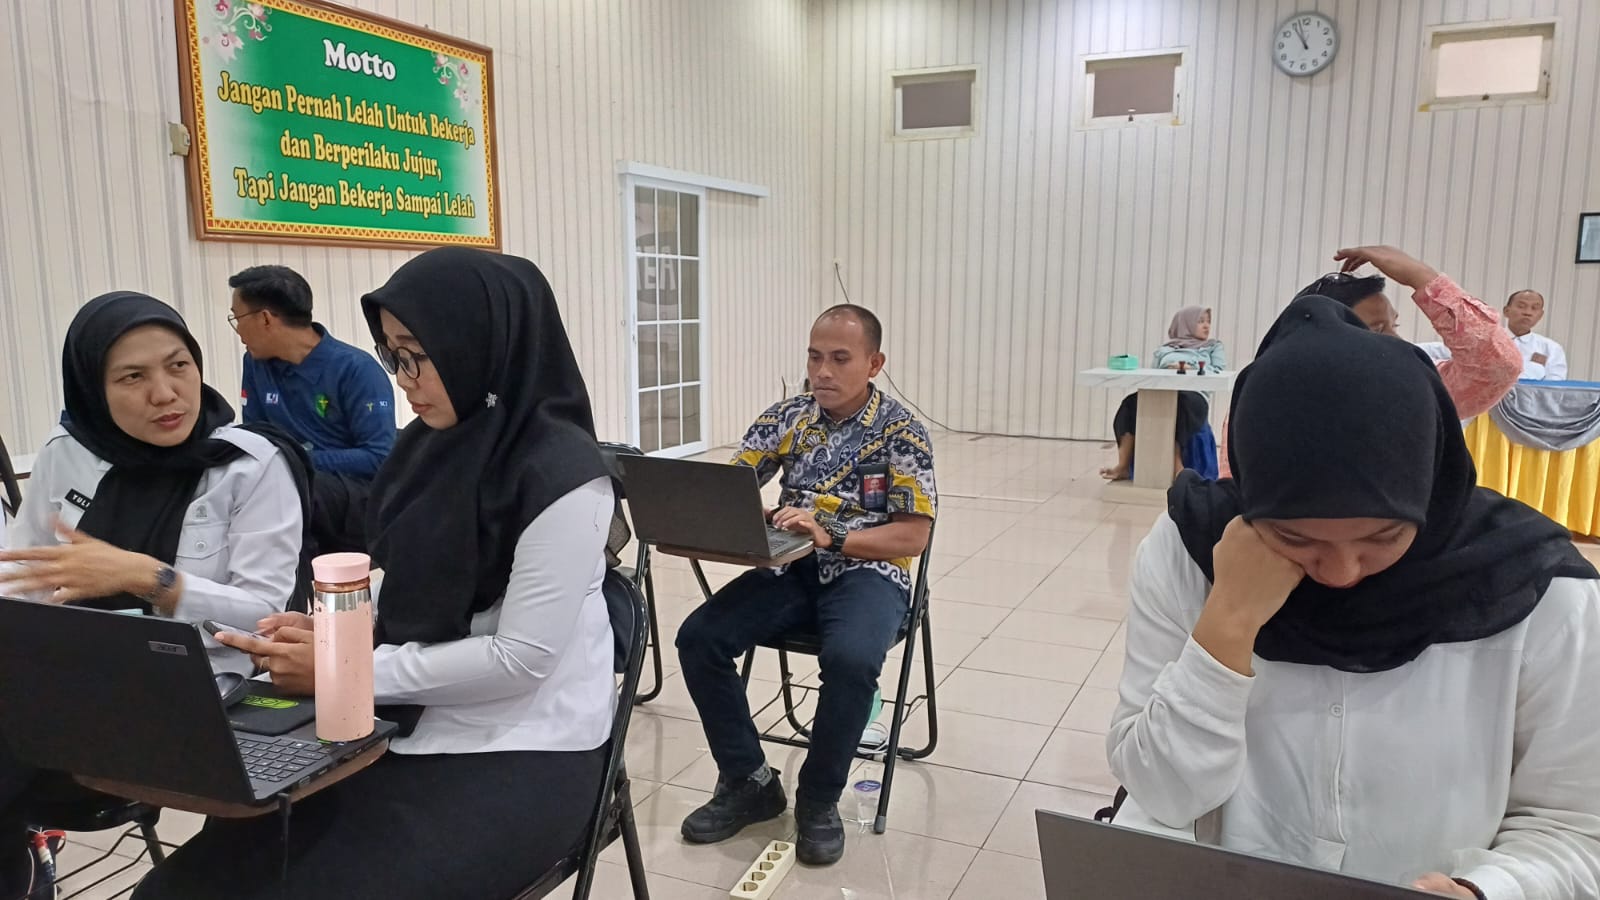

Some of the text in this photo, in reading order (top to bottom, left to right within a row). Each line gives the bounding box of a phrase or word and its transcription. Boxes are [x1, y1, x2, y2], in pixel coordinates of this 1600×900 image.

[1302, 17, 1312, 26] 12
[1323, 27, 1330, 36] 2
[1283, 30, 1292, 39] 10
[1326, 38, 1333, 46] 3
[323, 39, 396, 80] Motto
[218, 71, 476, 150] Jangan Pernah Lelah Untuk Bekerja
[280, 129, 441, 181] dan Berperilaku Jujur,
[234, 167, 475, 219] Tapi Jangan Bekerja Sampai Lelah
